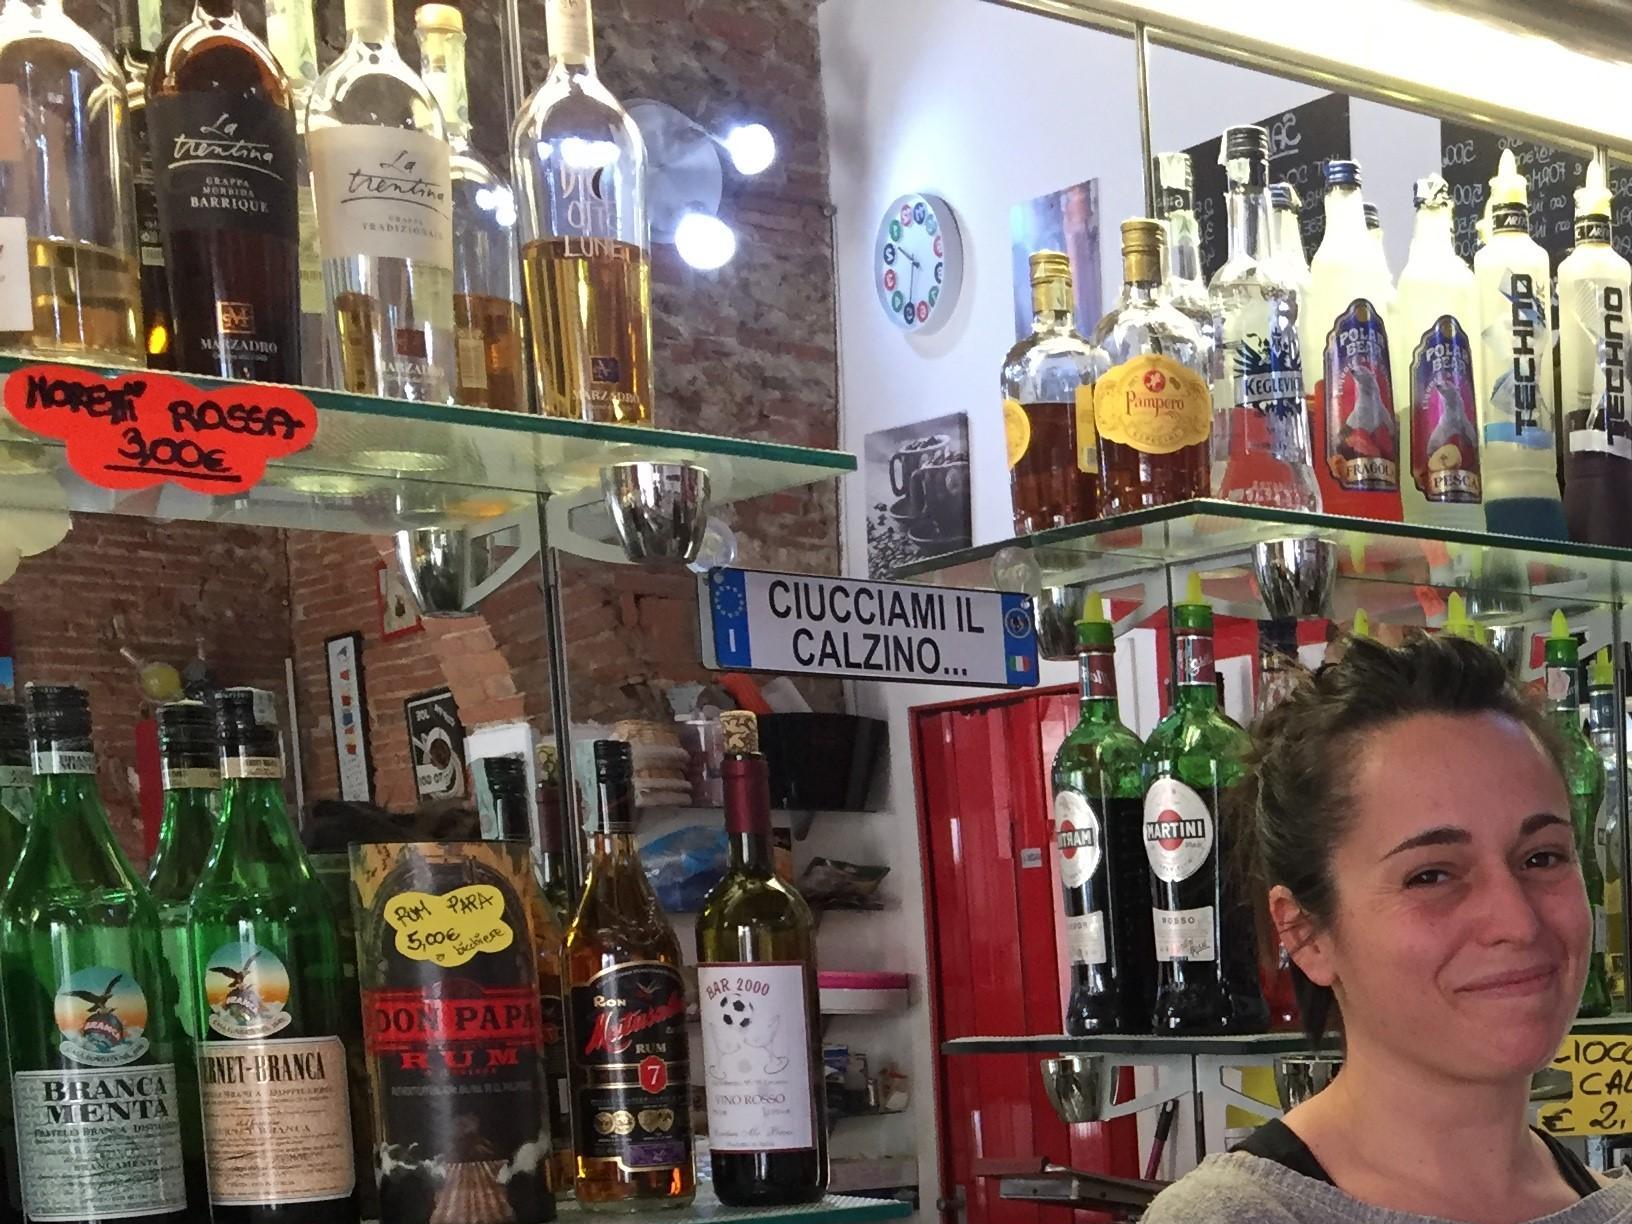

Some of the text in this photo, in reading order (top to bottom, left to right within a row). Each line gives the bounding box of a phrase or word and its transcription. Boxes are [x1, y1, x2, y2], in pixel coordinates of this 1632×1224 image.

[200, 112, 238, 136] La
[174, 134, 274, 164] trentina
[380, 150, 417, 173] La
[348, 172, 445, 202] trentina
[190, 196, 270, 213] BARRIQUE
[201, 337, 278, 354] MARZADRO
[1509, 272, 1538, 437] TECHNO
[1603, 286, 1625, 446] TECHNO
[1126, 391, 1185, 417] Pampero
[168, 400, 305, 439] ROSSA
[1434, 473, 1479, 490] PESCA
[769, 580, 985, 634] CIUCCIAMI IL
[793, 628, 968, 676] CALZINO...
[1147, 819, 1204, 840] MARTINI
[394, 892, 495, 927] RUM PAPA
[407, 928, 461, 953] 5,00€
[706, 977, 770, 1000] BAR 2000
[401, 1048, 520, 1070] RUM
[636, 1043, 667, 1054] RUM
[201, 1051, 326, 1085] ERNET-BRANCA
[647, 1065, 661, 1086] 7
[43, 1075, 167, 1101] BRANCA
[714, 1093, 786, 1105] VINO ROSSO
[45, 1099, 169, 1124] MENTA
